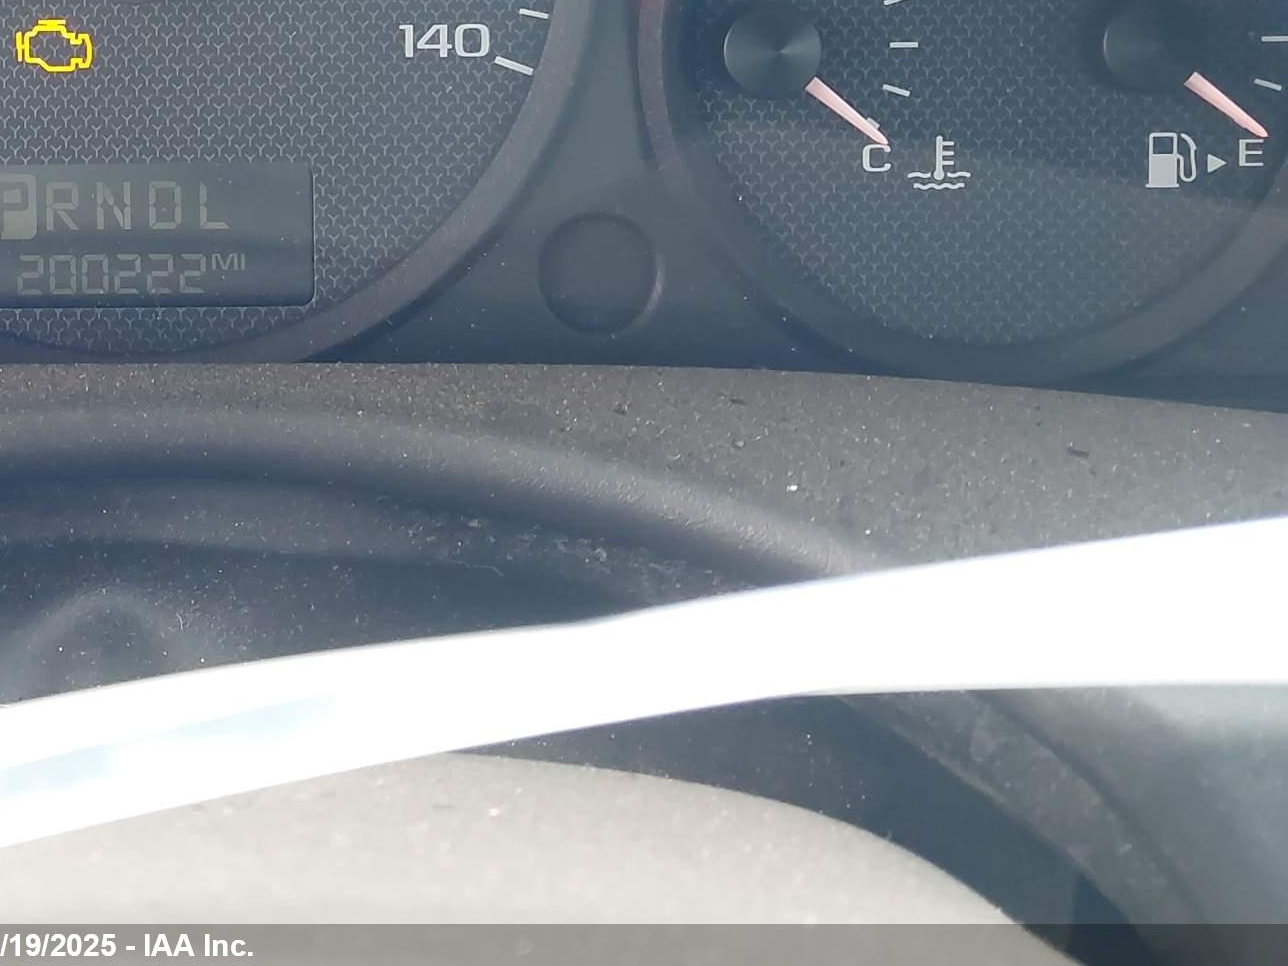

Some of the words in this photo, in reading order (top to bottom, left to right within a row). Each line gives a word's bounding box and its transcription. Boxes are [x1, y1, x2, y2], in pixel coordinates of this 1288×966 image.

[399, 24, 490, 59] 140
[862, 143, 892, 172] C
[1239, 138, 1265, 167] E
[16, 253, 208, 295] 200222
